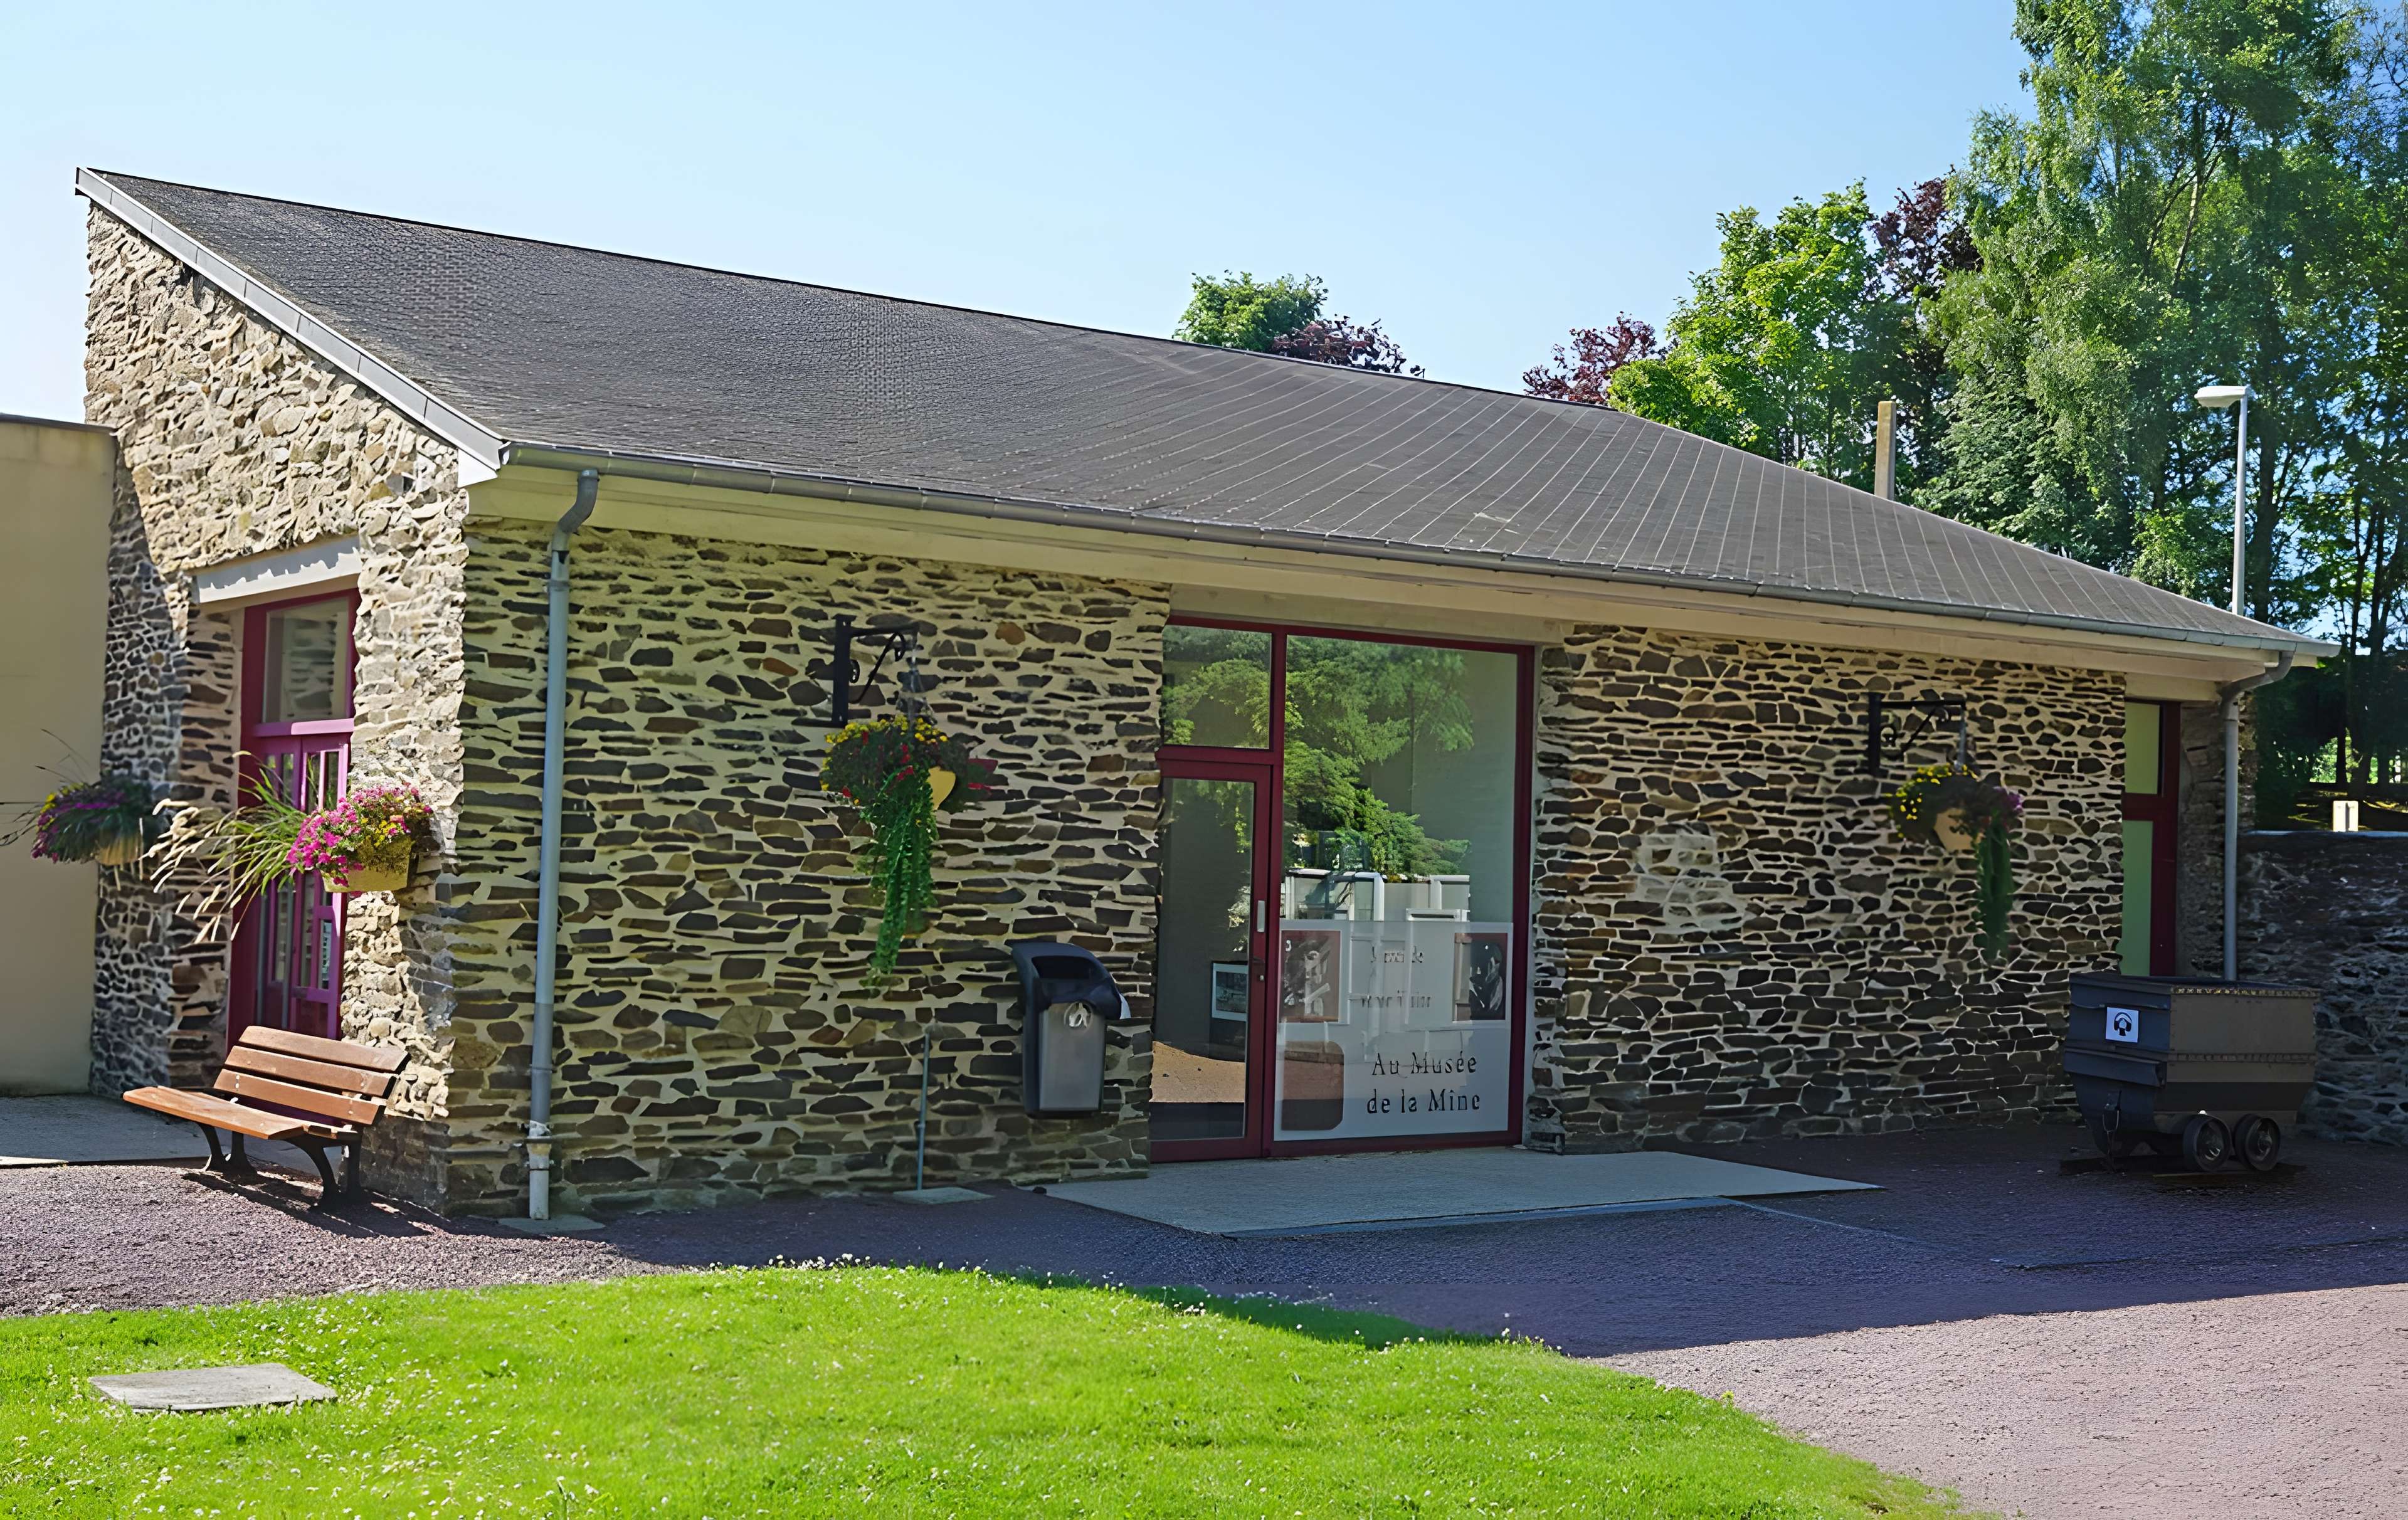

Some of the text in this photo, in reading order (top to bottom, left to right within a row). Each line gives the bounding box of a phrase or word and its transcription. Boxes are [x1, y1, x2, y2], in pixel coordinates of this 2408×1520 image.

[1371, 1050, 1477, 1075] Au Musée
[1366, 1089, 1390, 1114] de
[1401, 1089, 1417, 1113] la
